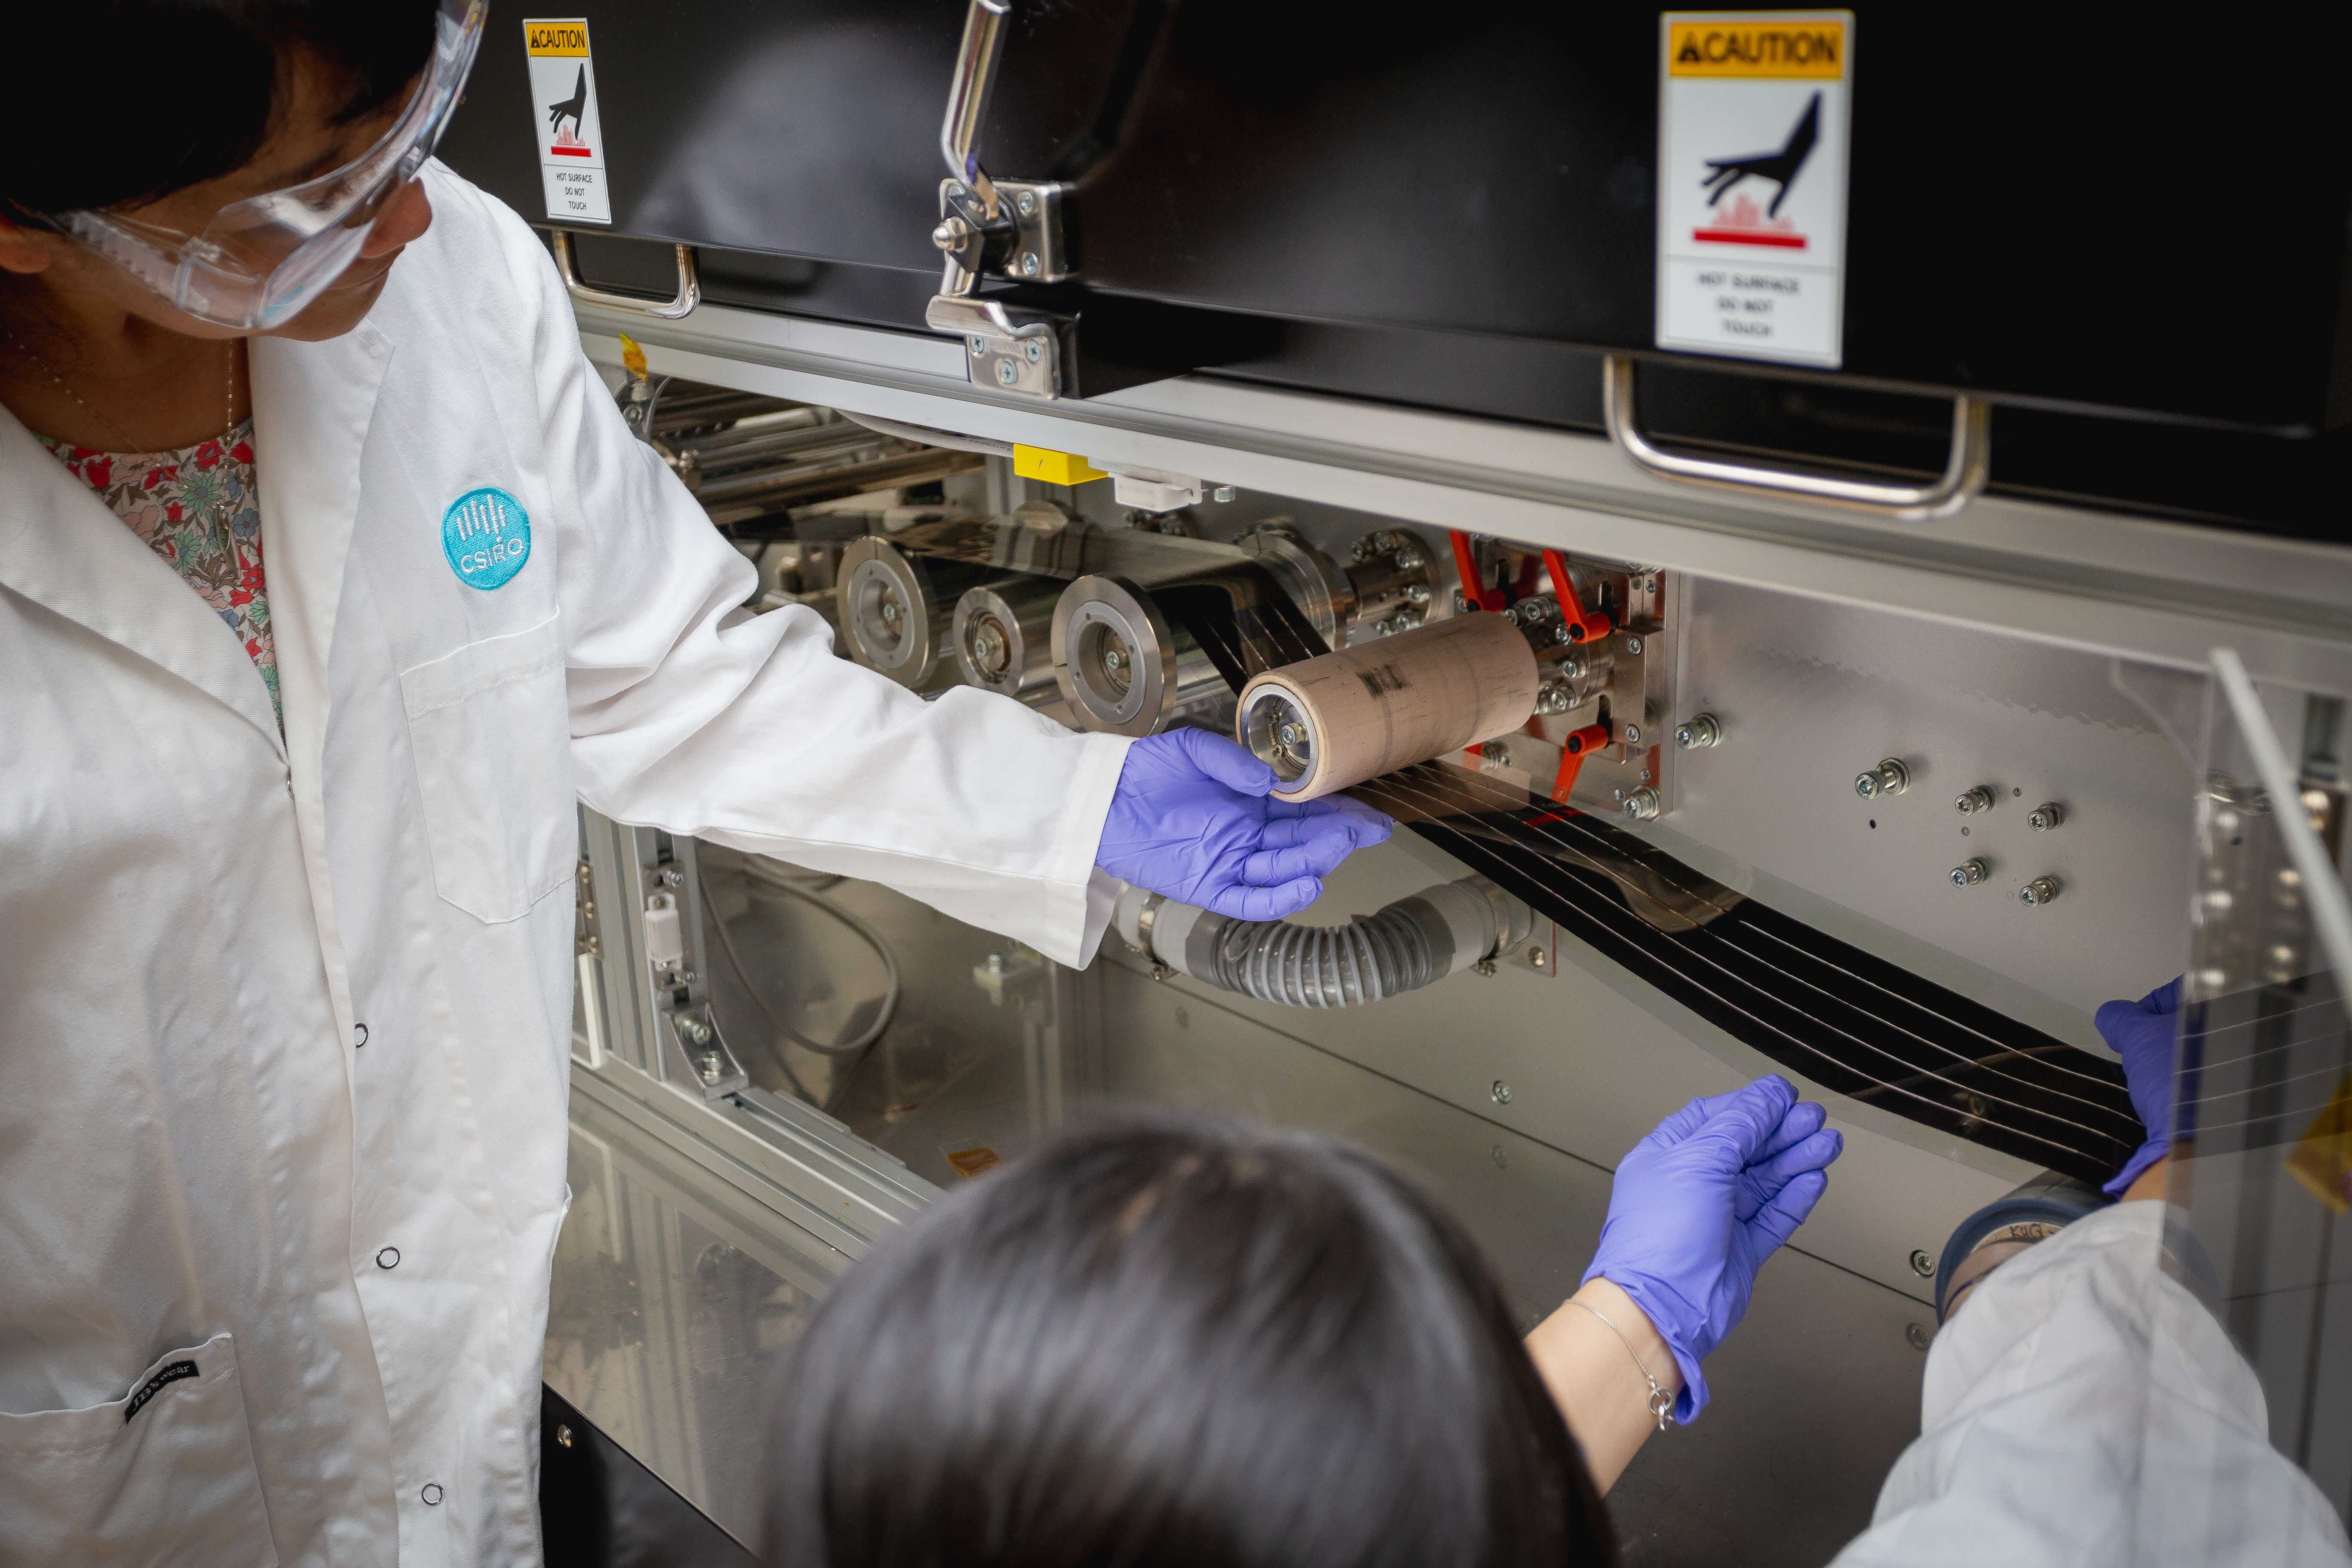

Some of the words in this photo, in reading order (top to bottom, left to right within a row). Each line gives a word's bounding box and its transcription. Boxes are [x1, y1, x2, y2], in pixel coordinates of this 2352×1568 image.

[539, 29, 585, 48] CAUTION
[1704, 30, 1836, 64] CAUTION
[556, 172, 567, 181] HOT
[568, 173, 592, 183] SURFACE
[565, 187, 573, 195] DO
[574, 187, 585, 196] NOT
[568, 201, 587, 210] TOUCH
[1698, 272, 1727, 287] HOT
[1732, 274, 1801, 294] SURFACE
[1716, 294, 1738, 311] DO
[1743, 298, 1773, 314] NOT
[1723, 318, 1774, 337] TOUCH
[461, 538, 524, 574] CSIRO
[133, 1381, 159, 1411] JB's
[159, 1366, 190, 1381] wear
